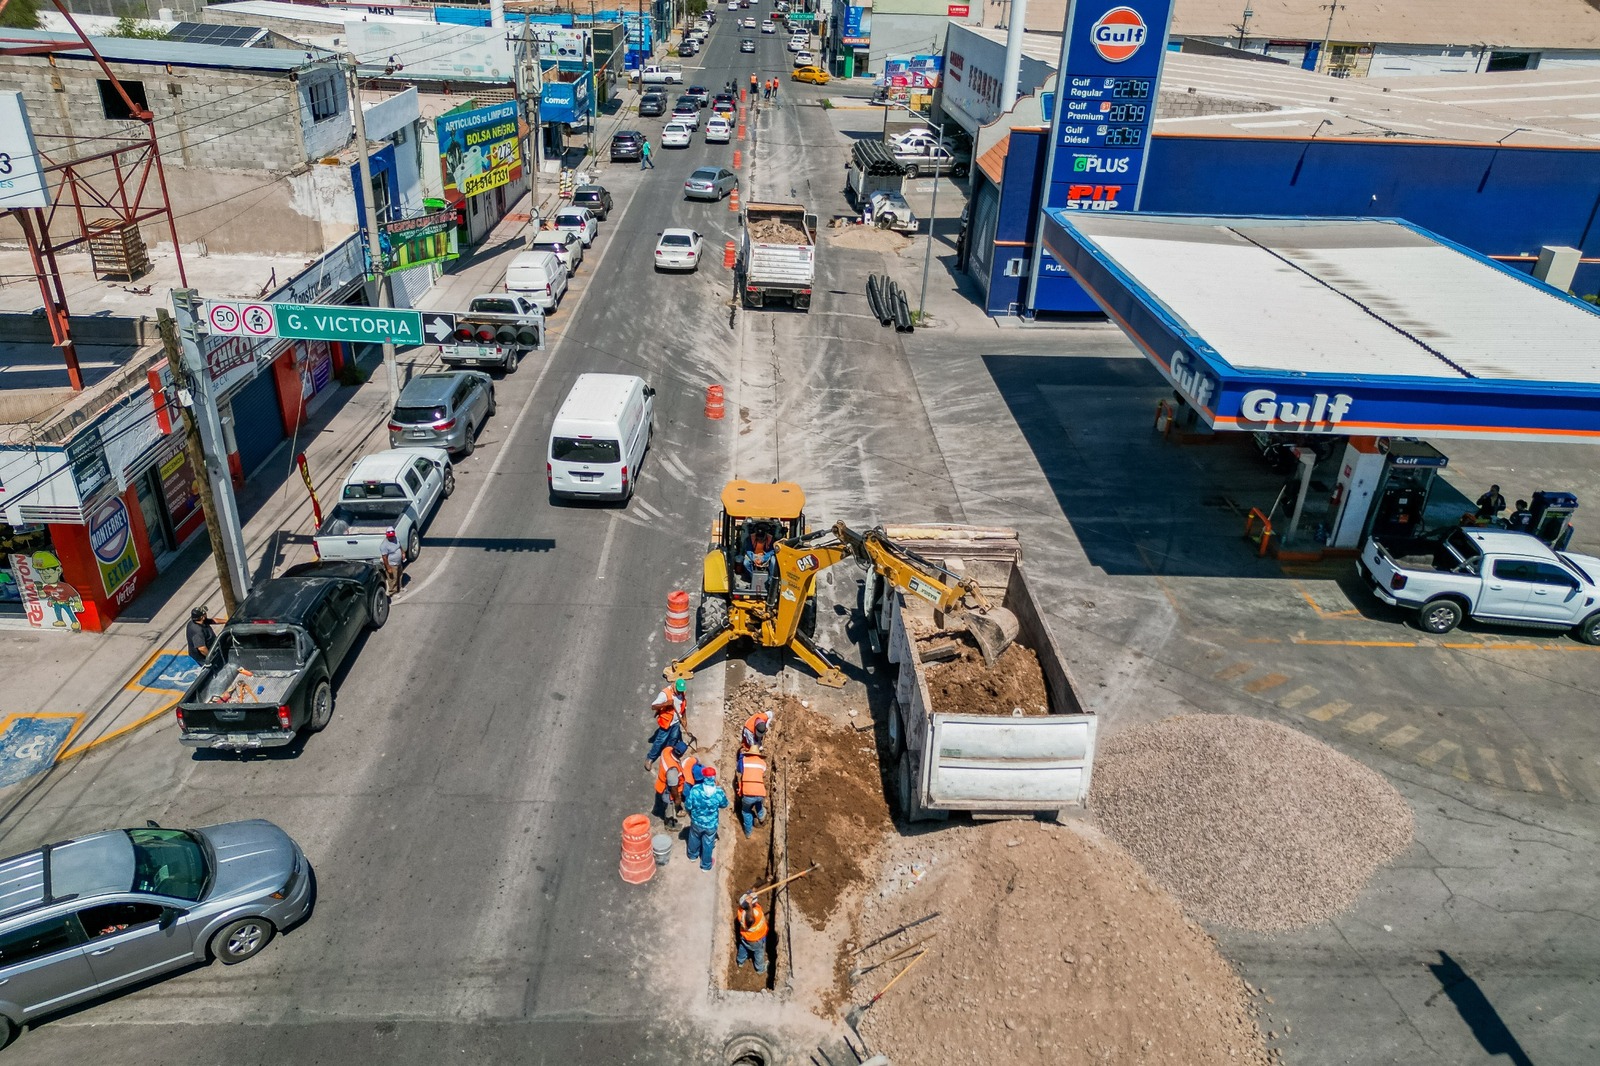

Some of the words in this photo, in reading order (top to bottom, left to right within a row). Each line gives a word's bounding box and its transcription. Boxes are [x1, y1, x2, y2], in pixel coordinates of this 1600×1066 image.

[1096, 26, 1143, 42] Gulf
[1072, 78, 1090, 87] Gulf
[544, 96, 570, 105] Comex
[1070, 89, 1103, 98] Regular
[1069, 102, 1087, 110] Gulf
[487, 106, 514, 122] LIMPIEZA
[1067, 112, 1104, 121] Premium
[466, 132, 491, 146] BOLSA
[492, 122, 517, 139] NEGRA
[1065, 126, 1083, 134] Gulf
[1064, 135, 1089, 144] Diésel
[493, 168, 509, 185] 7331
[1067, 185, 1122, 200] PIT
[1066, 200, 1119, 211] STOP
[216, 311, 234, 323] 50
[287, 314, 307, 331] G.
[314, 316, 411, 335] VICTORIA
[1171, 350, 1210, 406] Gulf
[1242, 389, 1353, 423] Gulf
[1396, 457, 1418, 465] Gulf
[91, 508, 127, 551] MONTERREY
[107, 555, 134, 587] EXTRA
[796, 555, 815, 572] CAT
[15, 554, 44, 628] REMATON
